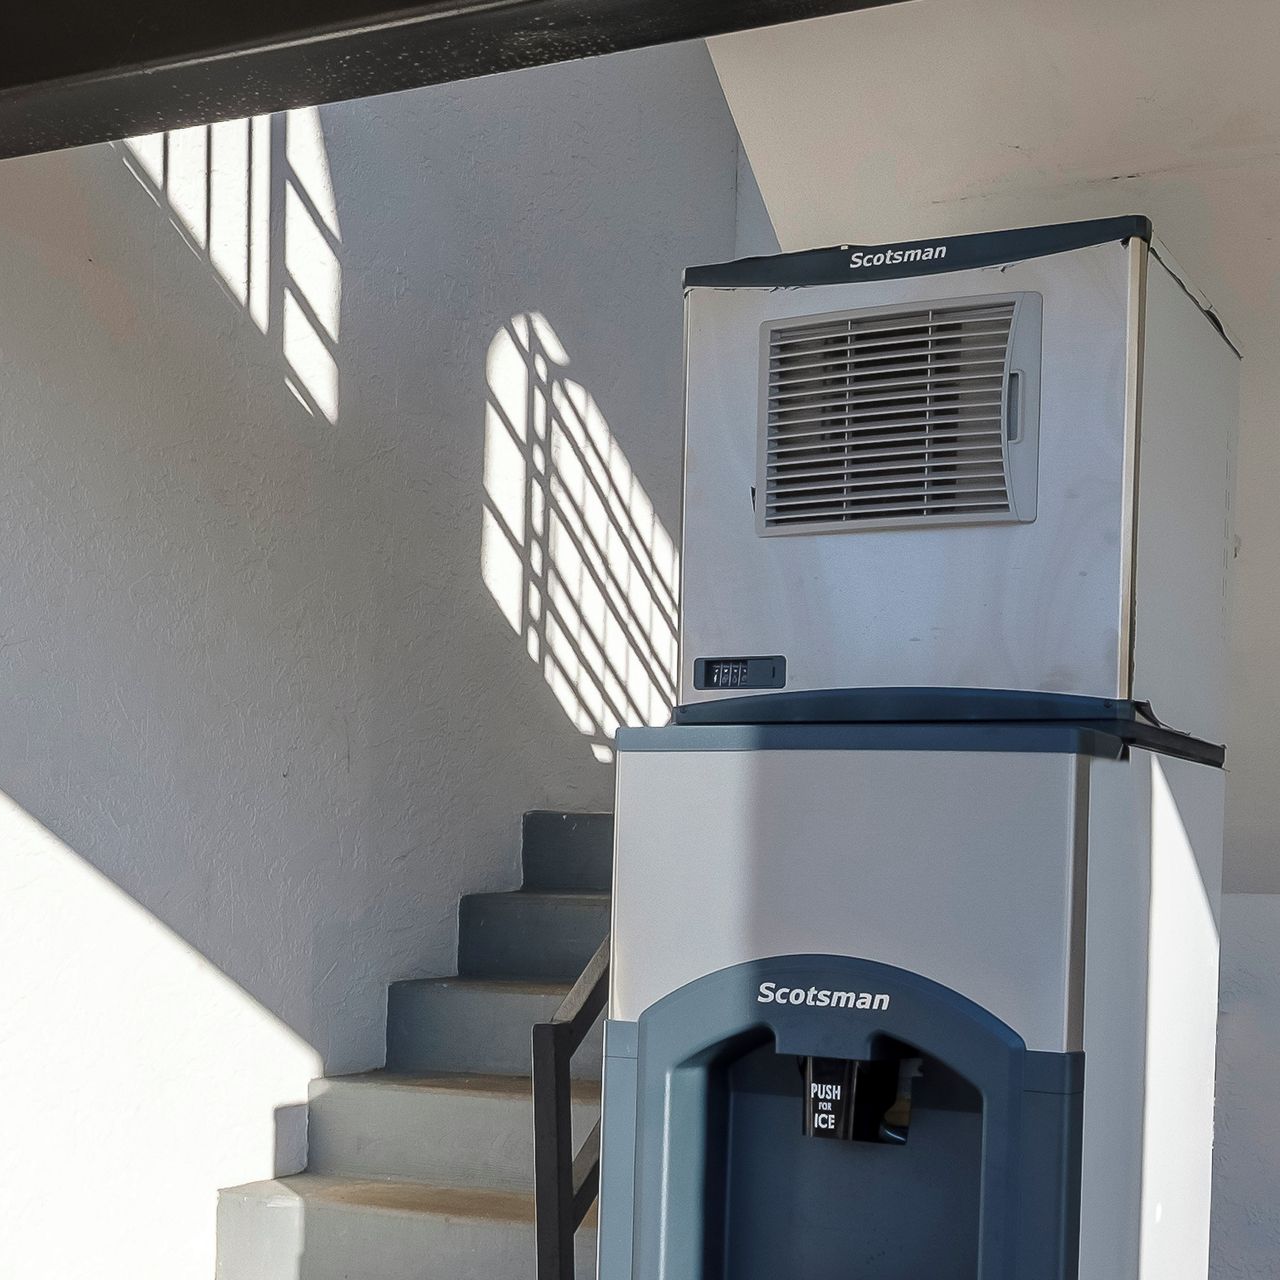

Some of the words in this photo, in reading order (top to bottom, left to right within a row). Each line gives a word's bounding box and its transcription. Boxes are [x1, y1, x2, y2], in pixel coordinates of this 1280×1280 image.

[849, 246, 947, 269] Scotsman
[757, 982, 890, 1010] Scotsman
[811, 1083, 841, 1100] PUSH
[818, 1102, 832, 1111] FOR
[814, 1113, 835, 1129] ICE
